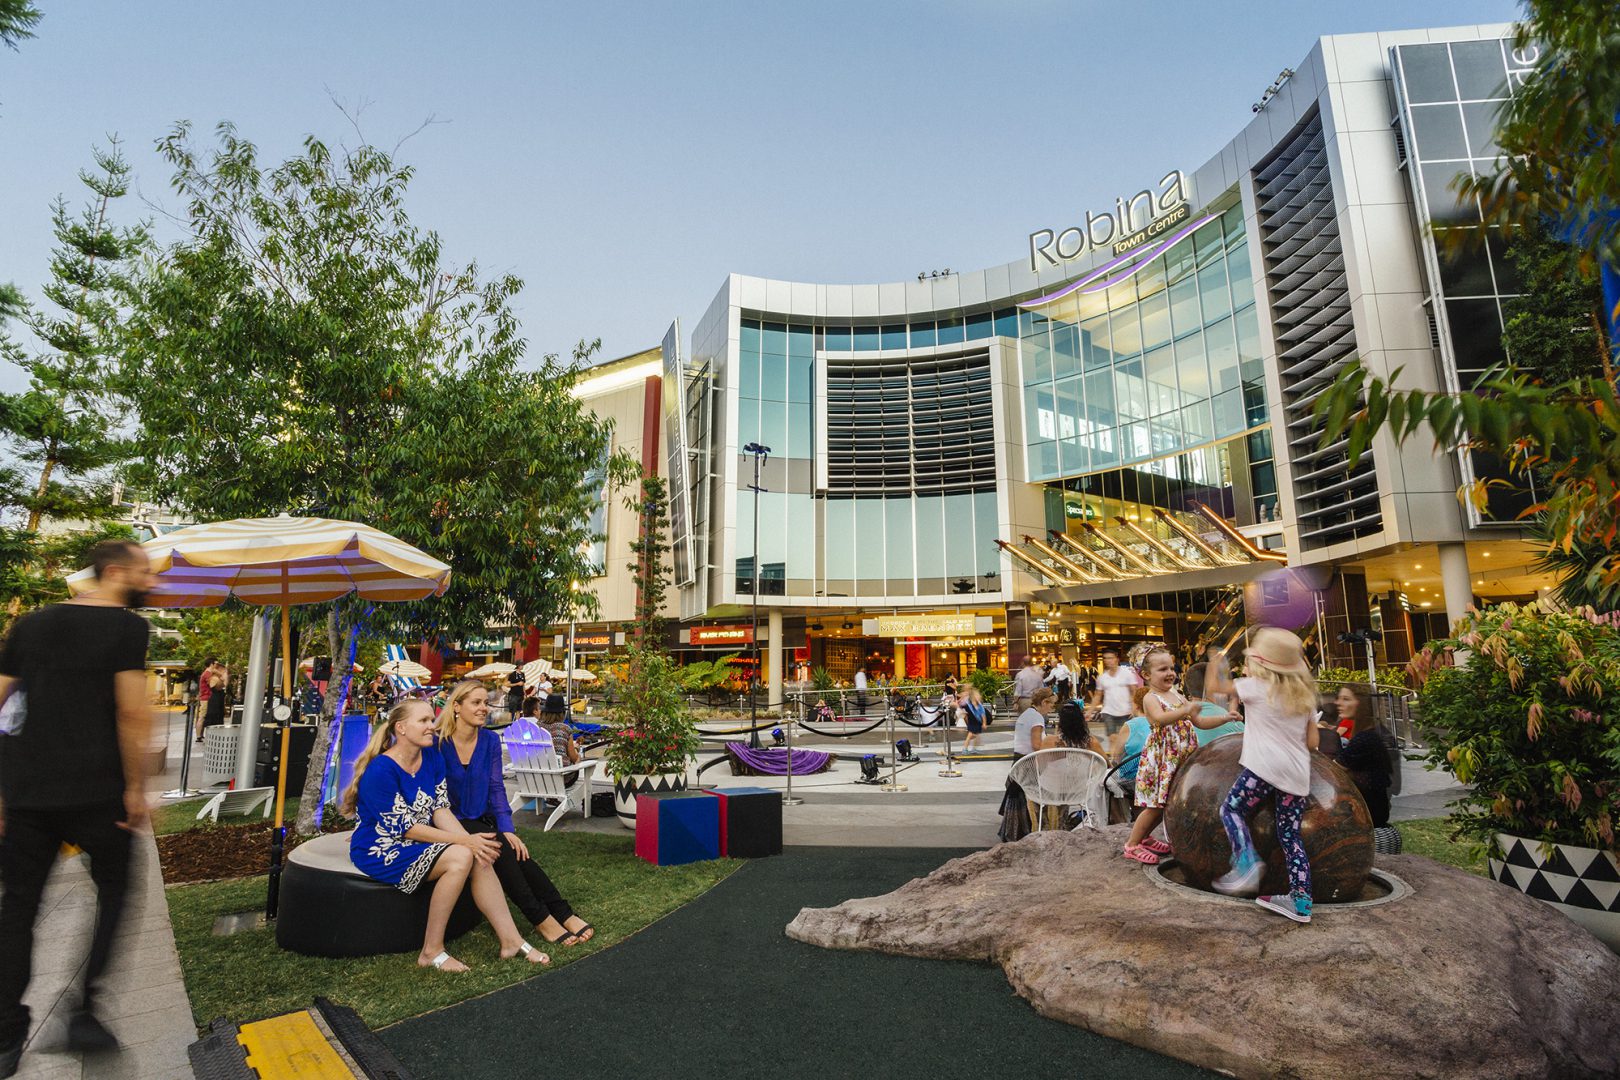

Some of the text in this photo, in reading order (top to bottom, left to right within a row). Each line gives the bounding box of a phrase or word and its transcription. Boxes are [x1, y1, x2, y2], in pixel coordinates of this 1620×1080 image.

[1029, 169, 1187, 273] Robina
[1113, 207, 1185, 254] Town Centre
[880, 624, 905, 633] MAX
